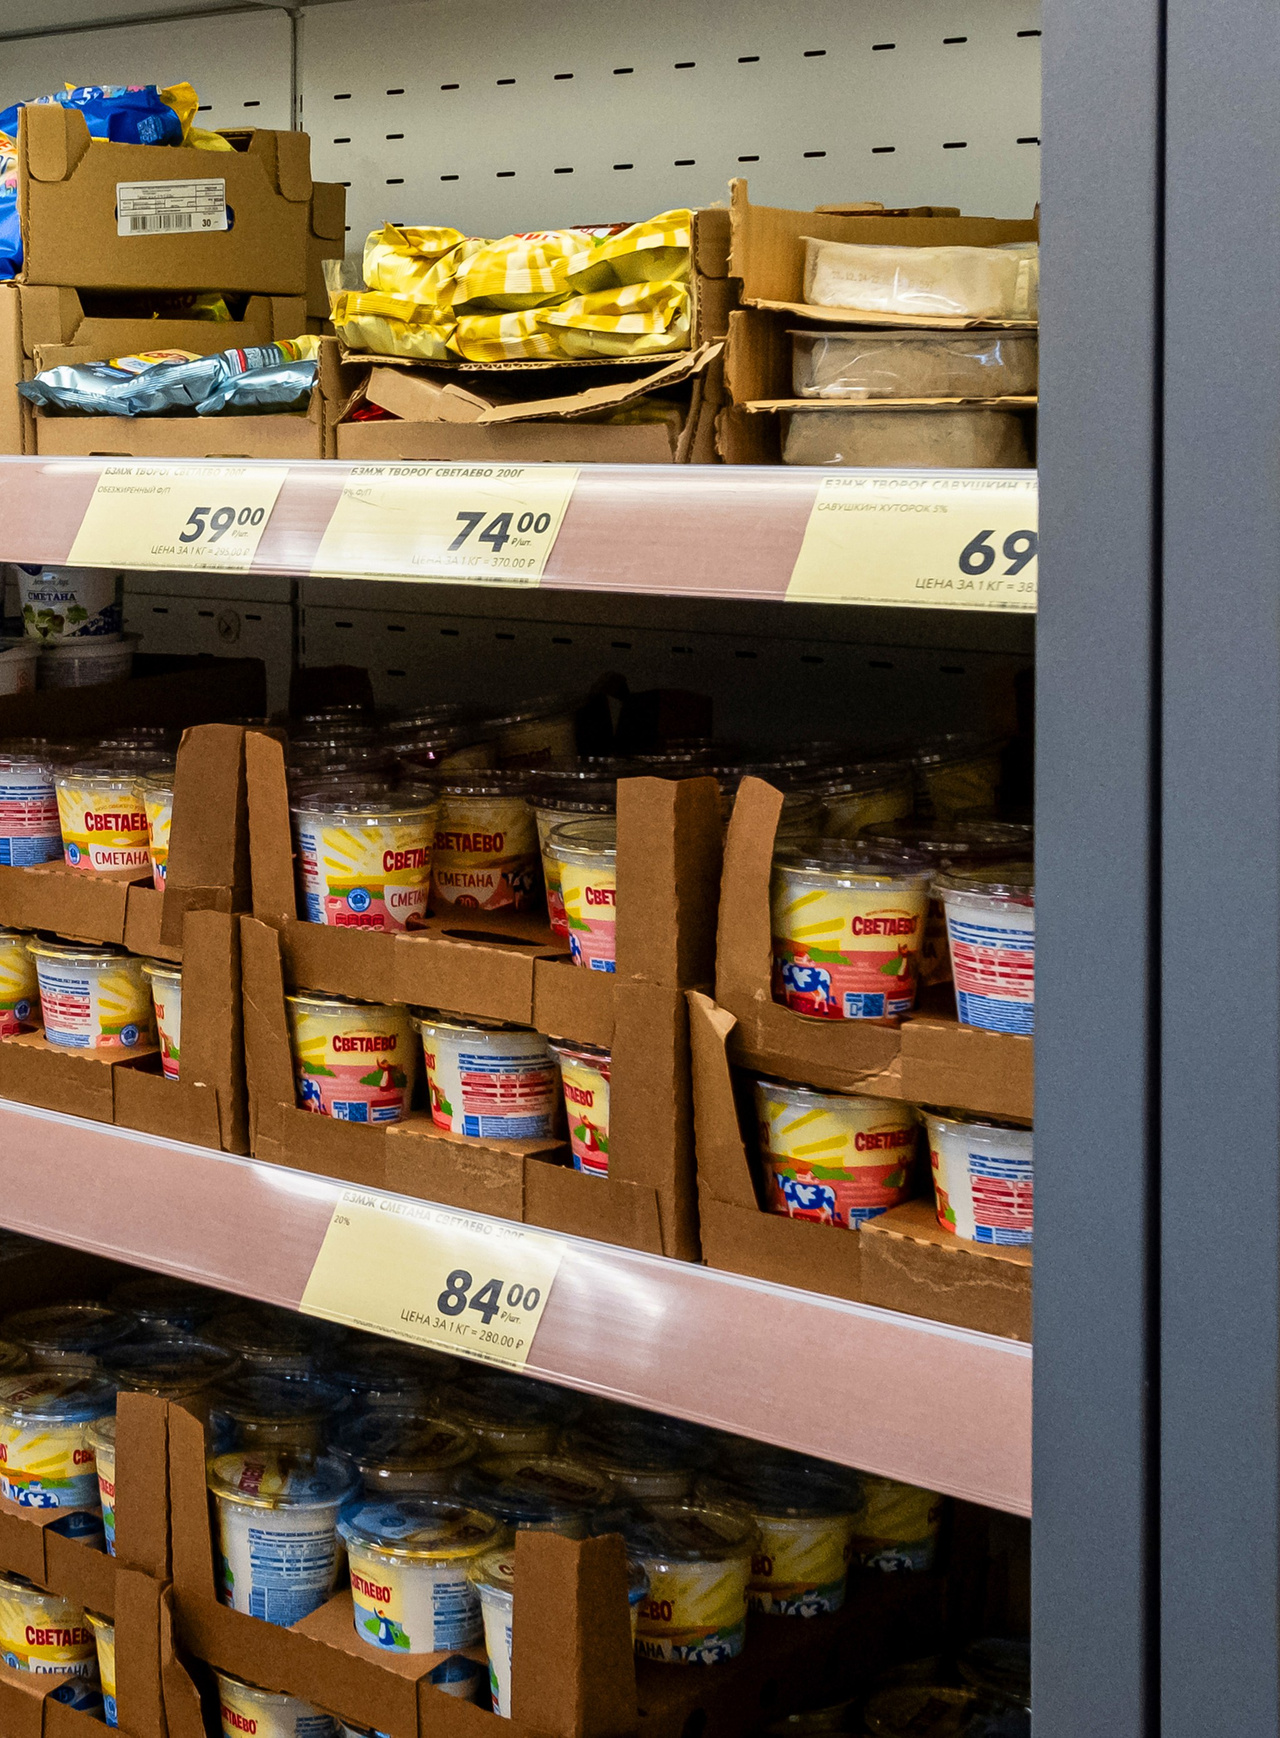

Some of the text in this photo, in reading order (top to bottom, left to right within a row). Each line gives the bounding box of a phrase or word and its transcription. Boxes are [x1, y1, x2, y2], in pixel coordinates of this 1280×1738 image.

[202, 219, 211, 227] 30
[350, 467, 524, 478] БЗМЖ ТВОРОГ СВЕТАЕВО 200Г
[817, 503, 948, 513] САВУШКИН ХУТОРОК 5%
[151, 545, 175, 555] ЦЕНА
[177, 546, 189, 555] ЗА
[196, 546, 207, 555] КГ
[491, 558, 524, 568] 370.00
[915, 578, 954, 590] ЦЕНА
[956, 579, 975, 590] ЗА
[986, 581, 1004, 591] КГ
[28, 592, 77, 601] СМЕТАНА
[85, 811, 148, 833] СВЕТАЕВ
[95, 851, 149, 866] СМЕТАНА
[438, 872, 493, 888] СМЕТАНА
[586, 887, 616, 906] СВЕТ
[333, 1035, 397, 1052] СВЕТАЕВО
[334, 1214, 351, 1226] 20%
[400, 1308, 515, 1348] ЦЕНА ЗА КГ 280.00
